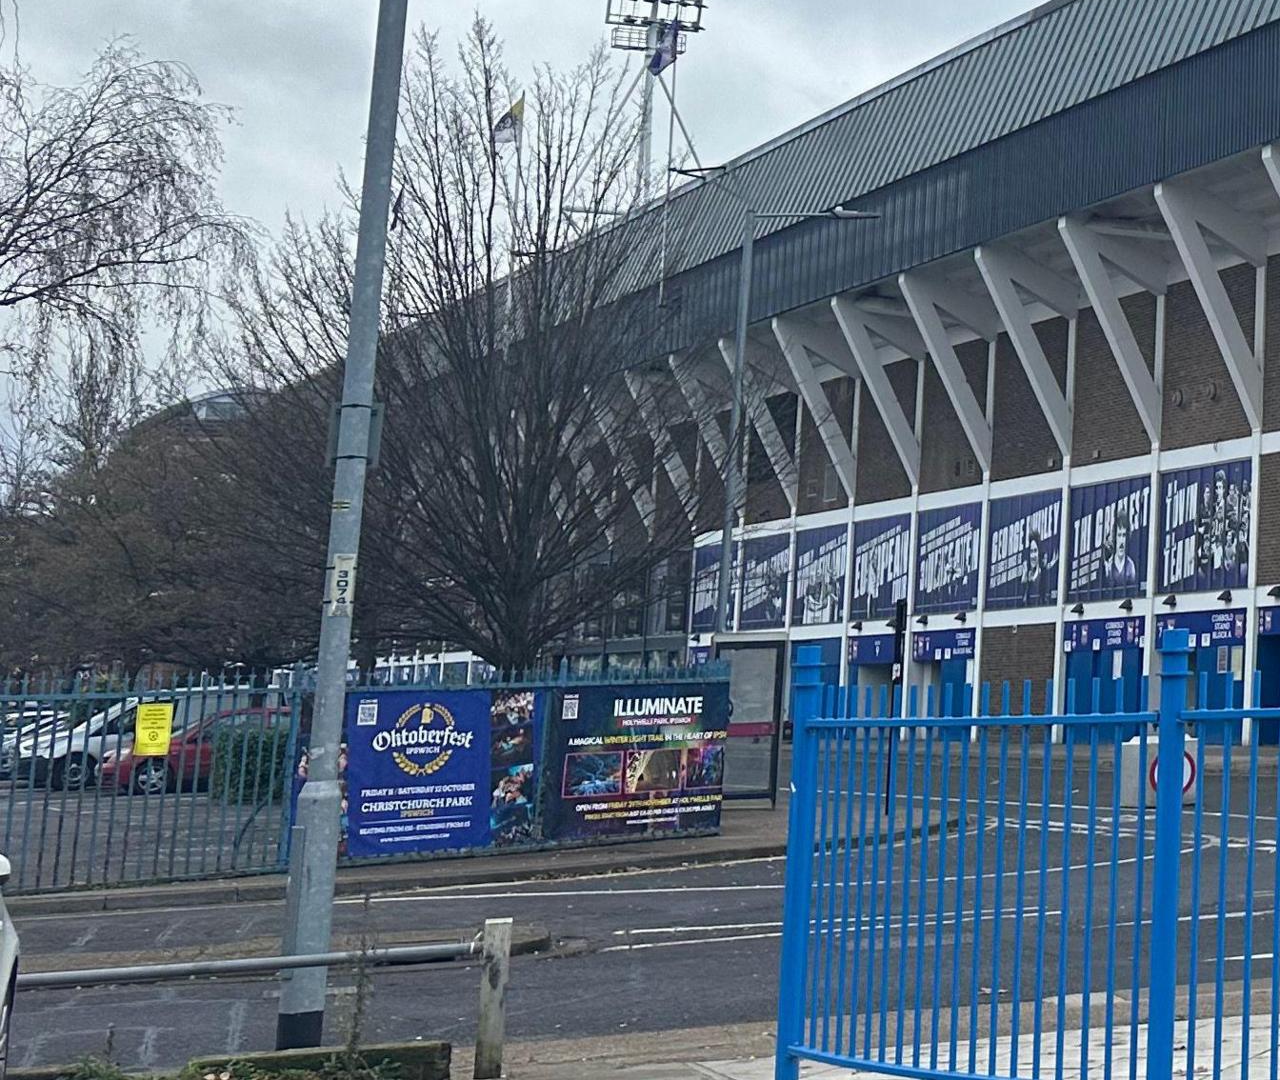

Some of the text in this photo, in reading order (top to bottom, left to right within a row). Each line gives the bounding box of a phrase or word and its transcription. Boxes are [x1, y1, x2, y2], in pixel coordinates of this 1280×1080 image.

[1165, 483, 1198, 532] TOWN
[992, 518, 1025, 564] GEORGE
[1163, 535, 1196, 587] TEAM
[614, 696, 703, 717] ILLUMINATE
[372, 725, 473, 751] Oktoberfest
[574, 737, 604, 745] MAGICAL
[406, 746, 441, 755] IPSWICH
[361, 789, 388, 797] FRIDAY
[398, 785, 435, 795] SATURDAY
[442, 783, 475, 792] OCTOBER
[361, 796, 473, 812] CHRISTCHURCH PARK
